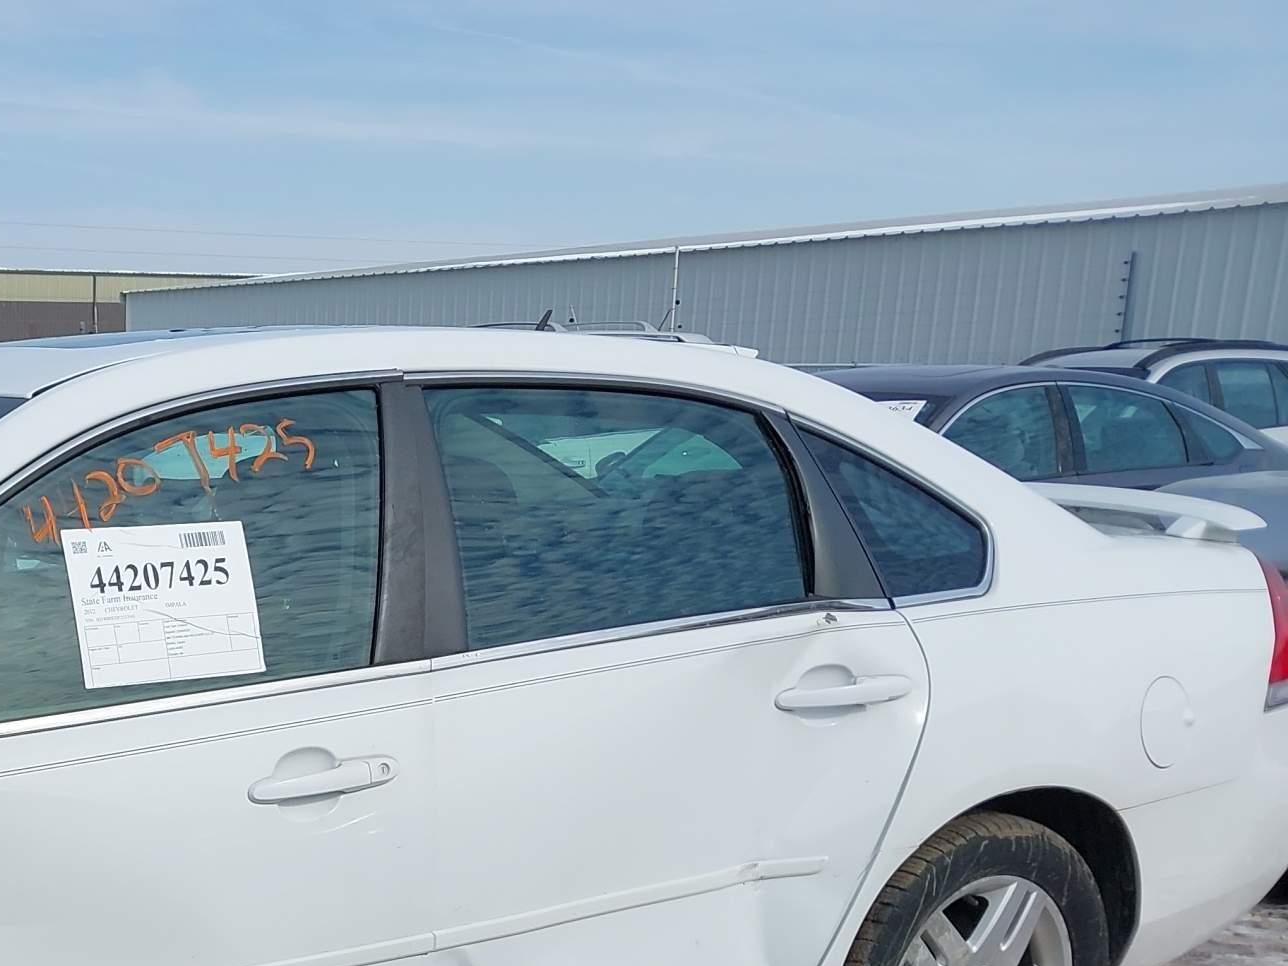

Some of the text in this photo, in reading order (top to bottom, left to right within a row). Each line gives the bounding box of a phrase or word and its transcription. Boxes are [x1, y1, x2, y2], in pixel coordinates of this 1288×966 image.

[90, 557, 230, 594] 44207425
[81, 593, 158, 606] State Farm Insurance
